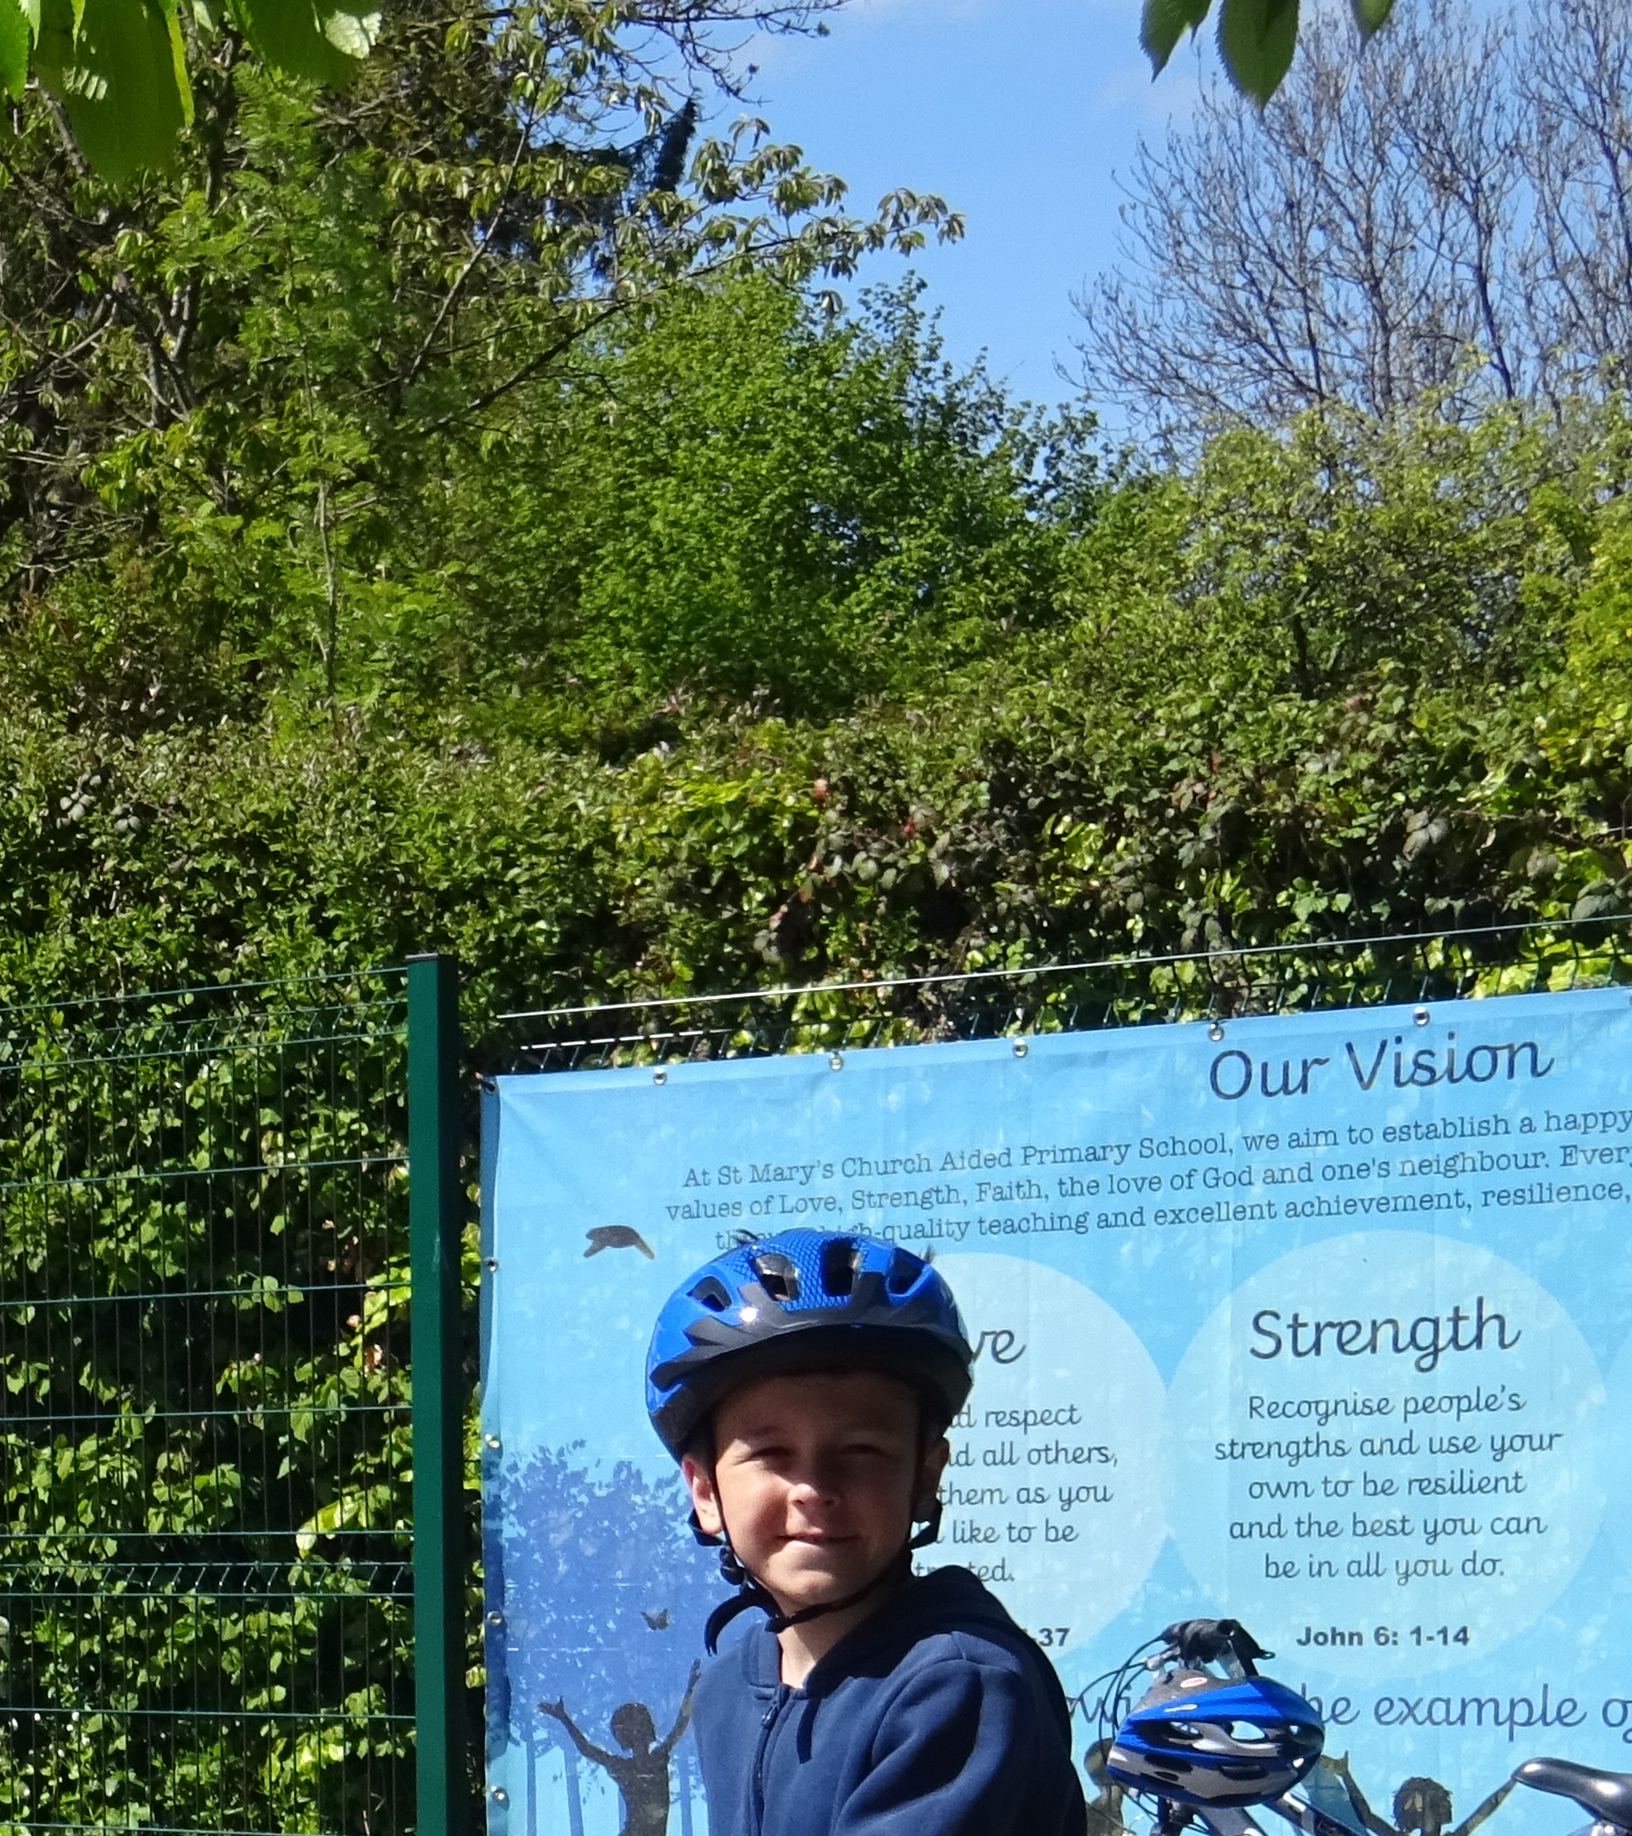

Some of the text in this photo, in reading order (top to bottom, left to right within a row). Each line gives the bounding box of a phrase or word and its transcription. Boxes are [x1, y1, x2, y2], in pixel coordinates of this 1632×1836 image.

[1209, 1031, 1555, 1100] Our Vision
[683, 1110, 1632, 1187] At St Mary's Church Aided Primary School, we aim to establish a happy
[666, 1144, 1632, 1221] values of Love, Strength, Faith, the love of God and one's neighbour. Ever
[978, 1210, 1090, 1236] teaching
[1097, 1206, 1146, 1229] and
[1154, 1199, 1277, 1226] excellent
[1285, 1189, 1472, 1219] achievement,
[1481, 1181, 1631, 1207] resilience,
[1249, 1295, 1522, 1374] Strength
[985, 1404, 1082, 1435] respect
[1248, 1384, 1526, 1426] Recognise people's
[982, 1441, 1020, 1467] all
[1027, 1439, 1118, 1467] others,
[1215, 1429, 1563, 1467] strengths and use your
[936, 1481, 1114, 1512] them as you
[1248, 1469, 1527, 1499] own to be resilient
[952, 1518, 1079, 1544] like to be
[1229, 1512, 1548, 1545] and the best you can
[1264, 1550, 1505, 1586] be in all you do.
[1295, 1625, 1471, 1647] John 6: 1-14
[1374, 1683, 1588, 1743] example
